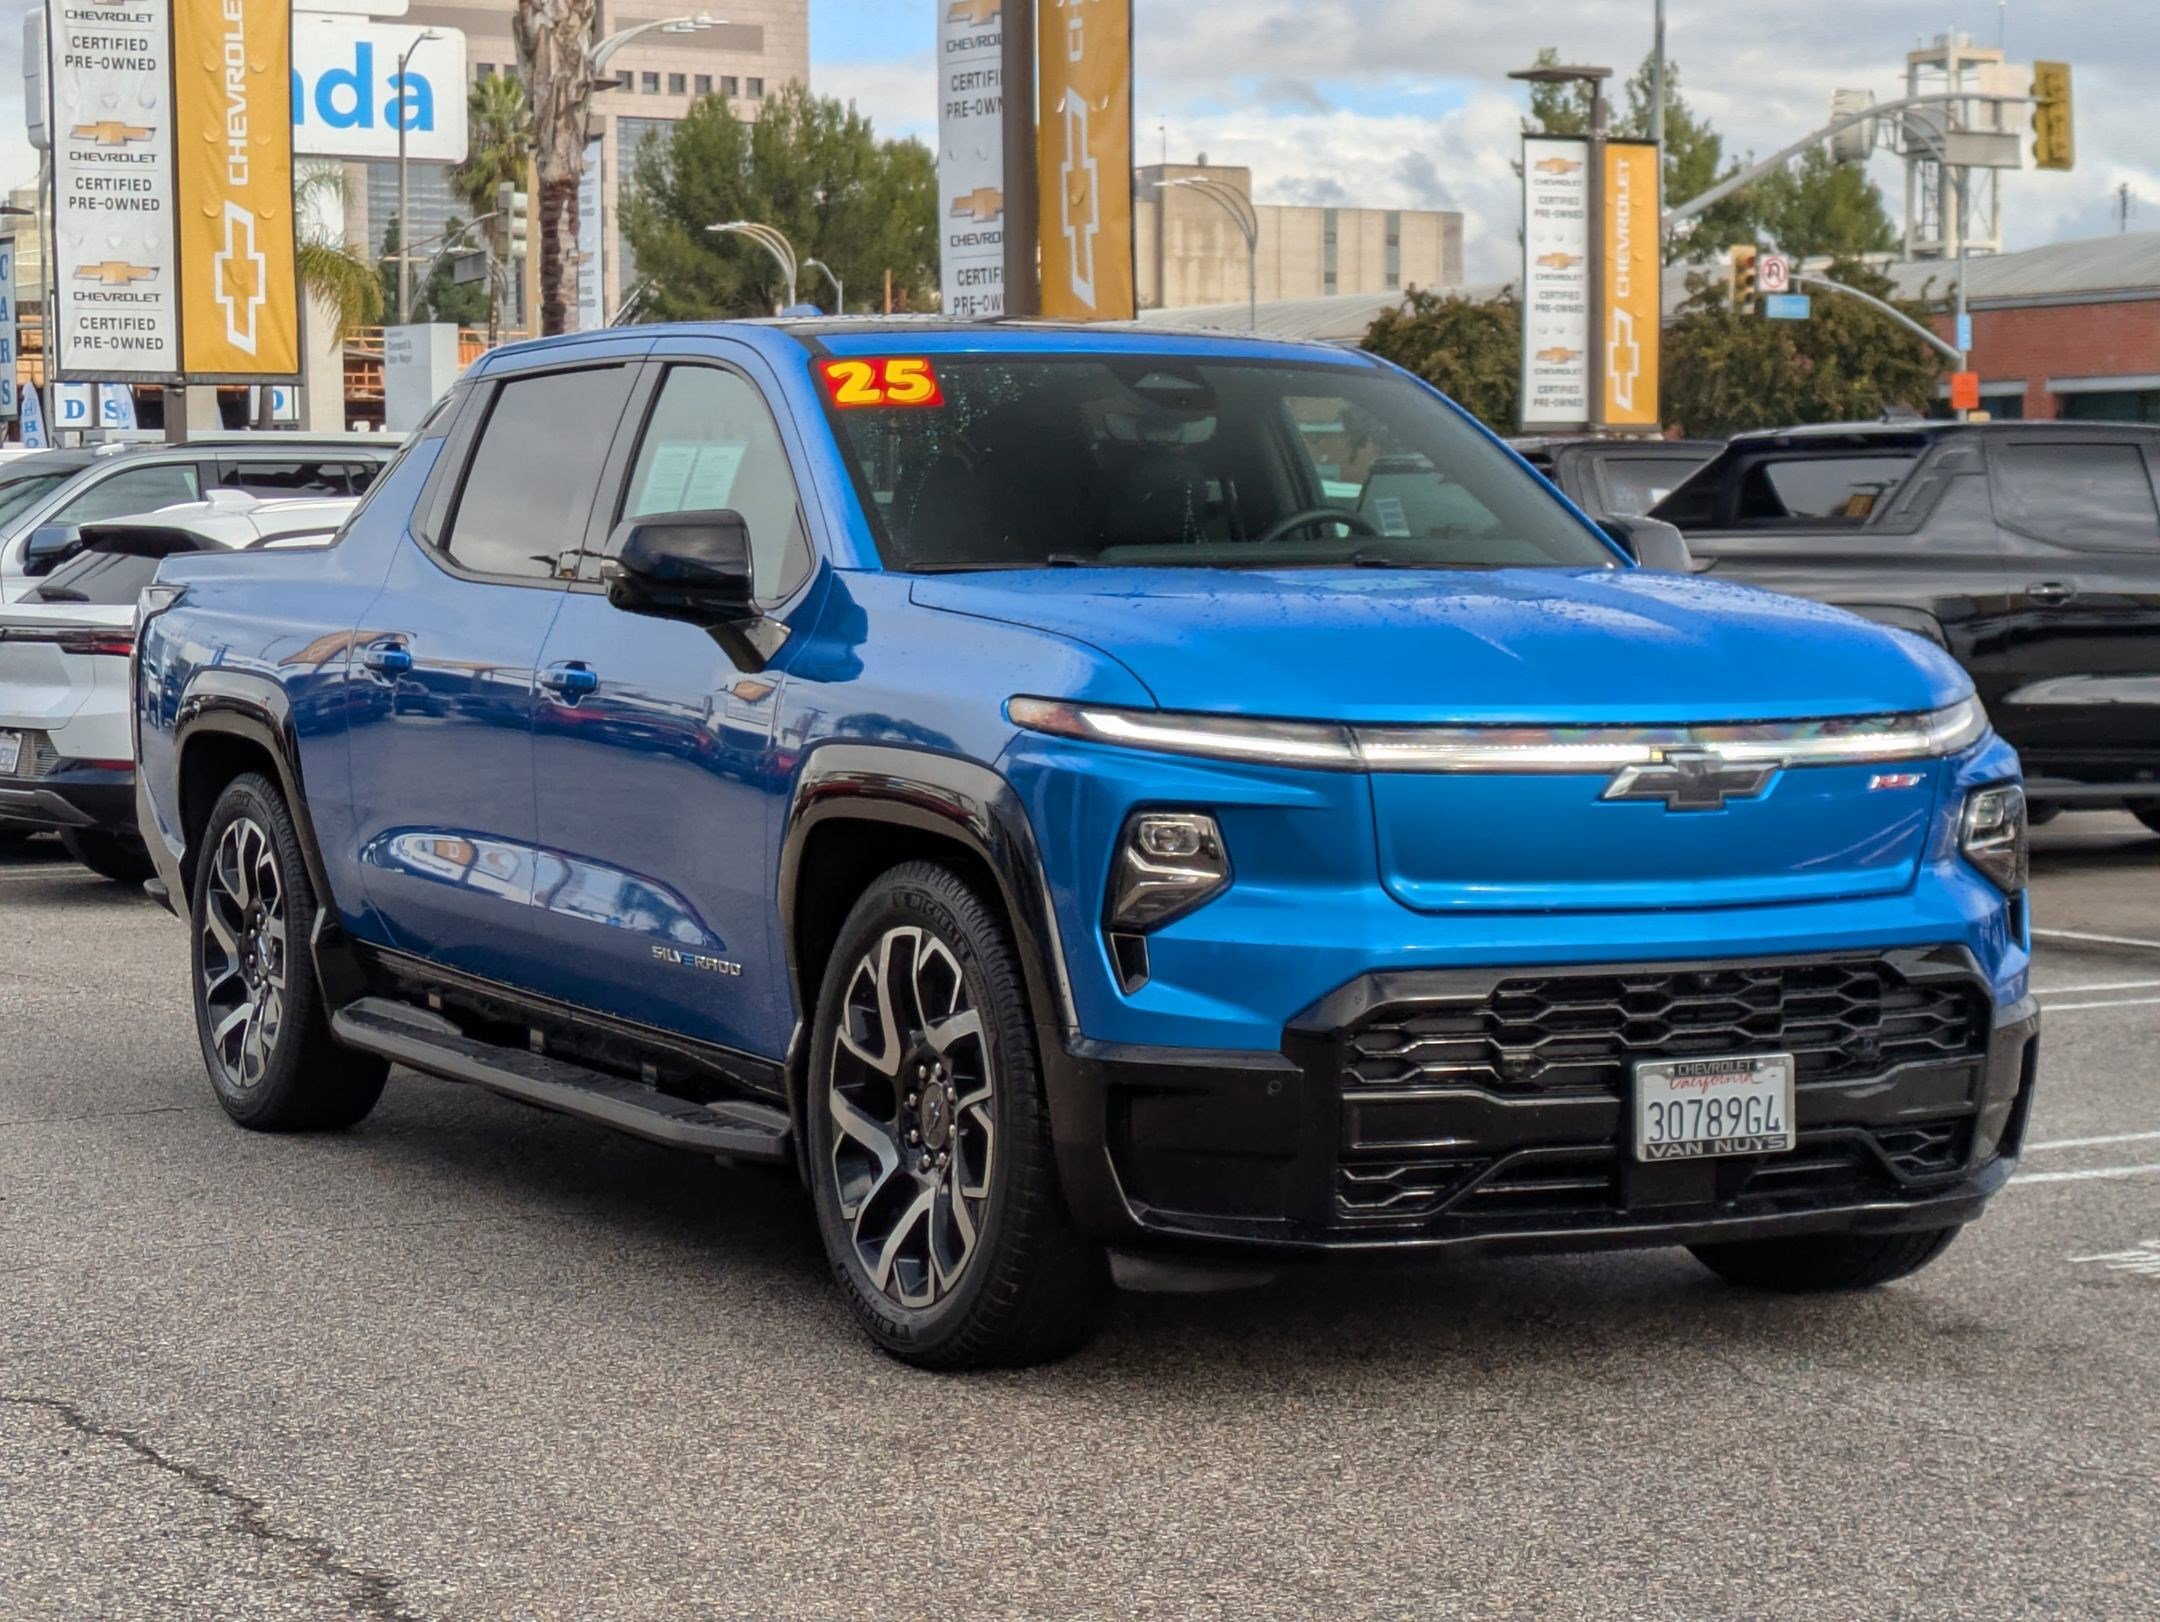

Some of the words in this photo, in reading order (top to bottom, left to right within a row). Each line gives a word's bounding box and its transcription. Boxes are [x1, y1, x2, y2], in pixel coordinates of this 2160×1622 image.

[65, 10, 154, 23] CHEVROLET
[72, 36, 148, 51] CERTIFIED
[65, 55, 156, 71] PRE-OWNED
[951, 69, 1002, 92] CERTIFI
[69, 151, 157, 163] CHEVROLET
[75, 177, 152, 191] CERTIFIED
[69, 196, 160, 211] PRE-OWNED
[1616, 158, 1631, 298] CHEVROLET
[73, 291, 161, 303] CHEVROLET
[80, 317, 156, 331] CERTIFIED
[73, 336, 164, 350] PRE-OWNED
[827, 359, 935, 404] 25
[652, 945, 742, 976] SILVERADO
[1678, 1060, 1753, 1076] CHEVROLET
[1648, 1095, 1781, 1142] 30789G4
[1647, 1141, 1704, 1159] VAN
[1714, 1135, 1787, 1152] NUYS
